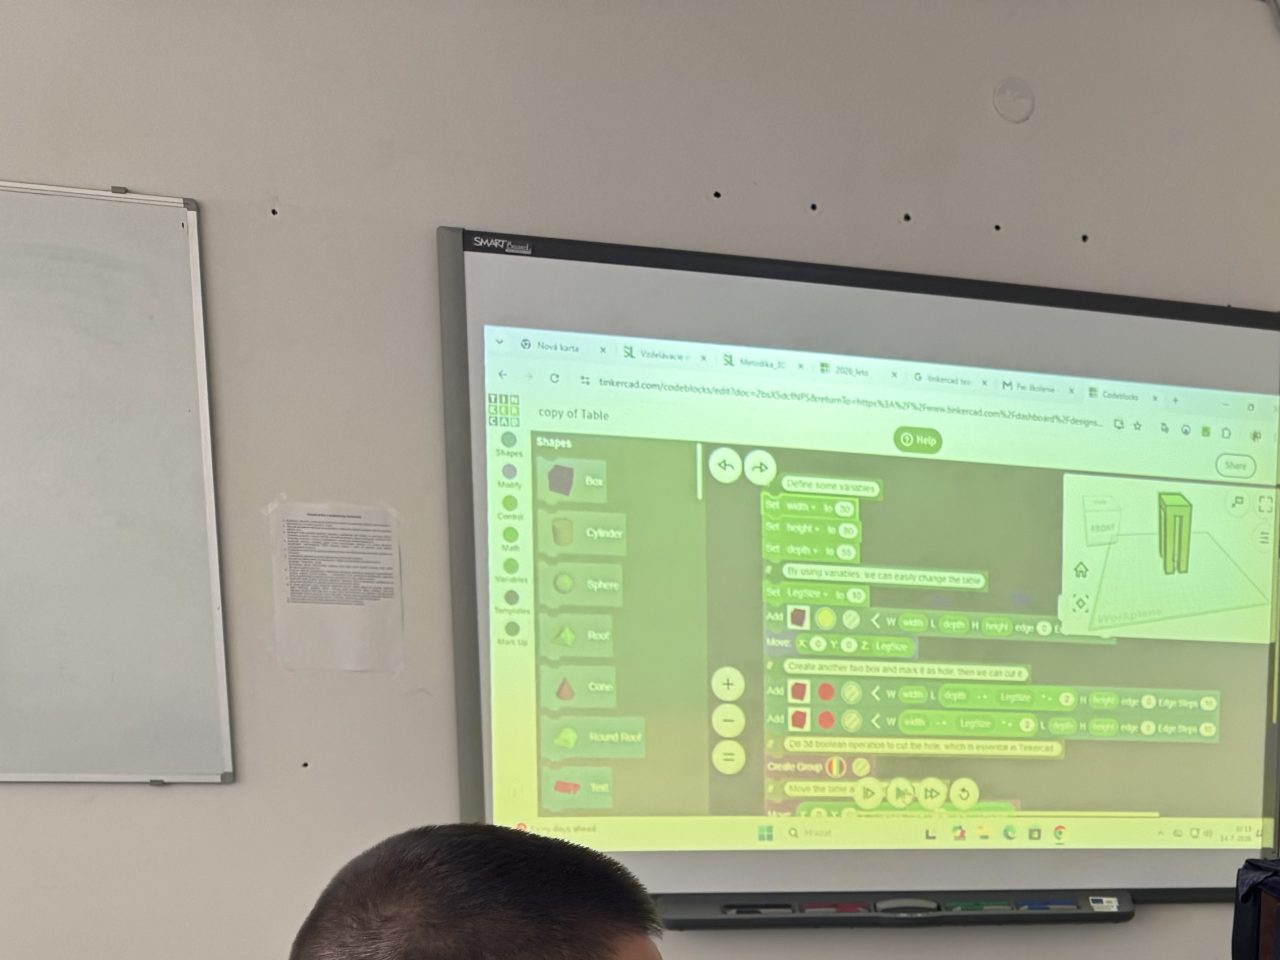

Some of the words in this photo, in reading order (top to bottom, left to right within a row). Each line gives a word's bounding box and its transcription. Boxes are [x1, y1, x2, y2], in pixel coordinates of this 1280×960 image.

[473, 236, 507, 249] SMART
[537, 341, 558, 351] Nová
[560, 344, 580, 353] karta
[538, 408, 564, 420] copy
[566, 408, 578, 419] of
[582, 409, 610, 421] Table
[536, 436, 573, 449] Shapes
[916, 434, 937, 448] Help
[496, 449, 523, 458] Shapes
[1225, 460, 1247, 471] Share
[585, 475, 604, 486] Box
[786, 479, 814, 489] Define
[815, 482, 837, 490] some
[840, 482, 875, 494] variables
[765, 499, 780, 510] Set
[786, 501, 809, 511] width
[823, 503, 834, 513] to
[585, 527, 624, 540] Cylinder
[765, 521, 780, 531] Set
[786, 522, 813, 535] height
[827, 525, 837, 535] to
[1090, 523, 1116, 533] FRONT
[765, 543, 780, 553] Set
[786, 544, 811, 556] depth
[825, 547, 835, 556] to
[787, 566, 798, 576] By
[800, 567, 822, 577] using
[879, 572, 893, 580] can
[894, 572, 917, 583] easily
[918, 573, 946, 584] change
[948, 575, 962, 584] the
[962, 576, 982, 585] table
[586, 579, 620, 592] Sphere
[766, 587, 781, 597] Set
[835, 591, 845, 600] to
[766, 611, 784, 622] Add
[886, 617, 896, 626] W
[902, 617, 924, 627] width
[942, 619, 966, 631] depth
[972, 621, 979, 630] H
[985, 620, 1009, 633] height
[1015, 623, 1035, 634] edge
[1097, 608, 1162, 624] Workplane
[587, 630, 611, 641] Roof
[788, 661, 816, 671] Create
[817, 662, 848, 672] another
[849, 664, 865, 673] two
[865, 664, 880, 673] box
[882, 665, 897, 674] and
[957, 668, 976, 677] then
[989, 670, 1004, 678] can
[588, 681, 614, 692] Cone
[767, 686, 785, 696] Add
[886, 689, 896, 698] W
[903, 689, 924, 698] width
[943, 690, 966, 701] depth
[1120, 697, 1139, 708] edge
[1158, 698, 1175, 709] Edge
[1177, 699, 1198, 710] Steps
[767, 713, 785, 724] Add
[886, 717, 896, 726] W
[903, 717, 926, 727] width
[1120, 723, 1139, 734] edge
[1158, 724, 1174, 735] Edge
[1177, 725, 1197, 736] Steps
[589, 731, 619, 742] Round
[620, 731, 642, 742] Roof
[910, 741, 923, 749] the
[943, 742, 966, 751] which
[767, 761, 796, 772] Create
[796, 761, 823, 774] Group
[590, 782, 610, 793] Text
